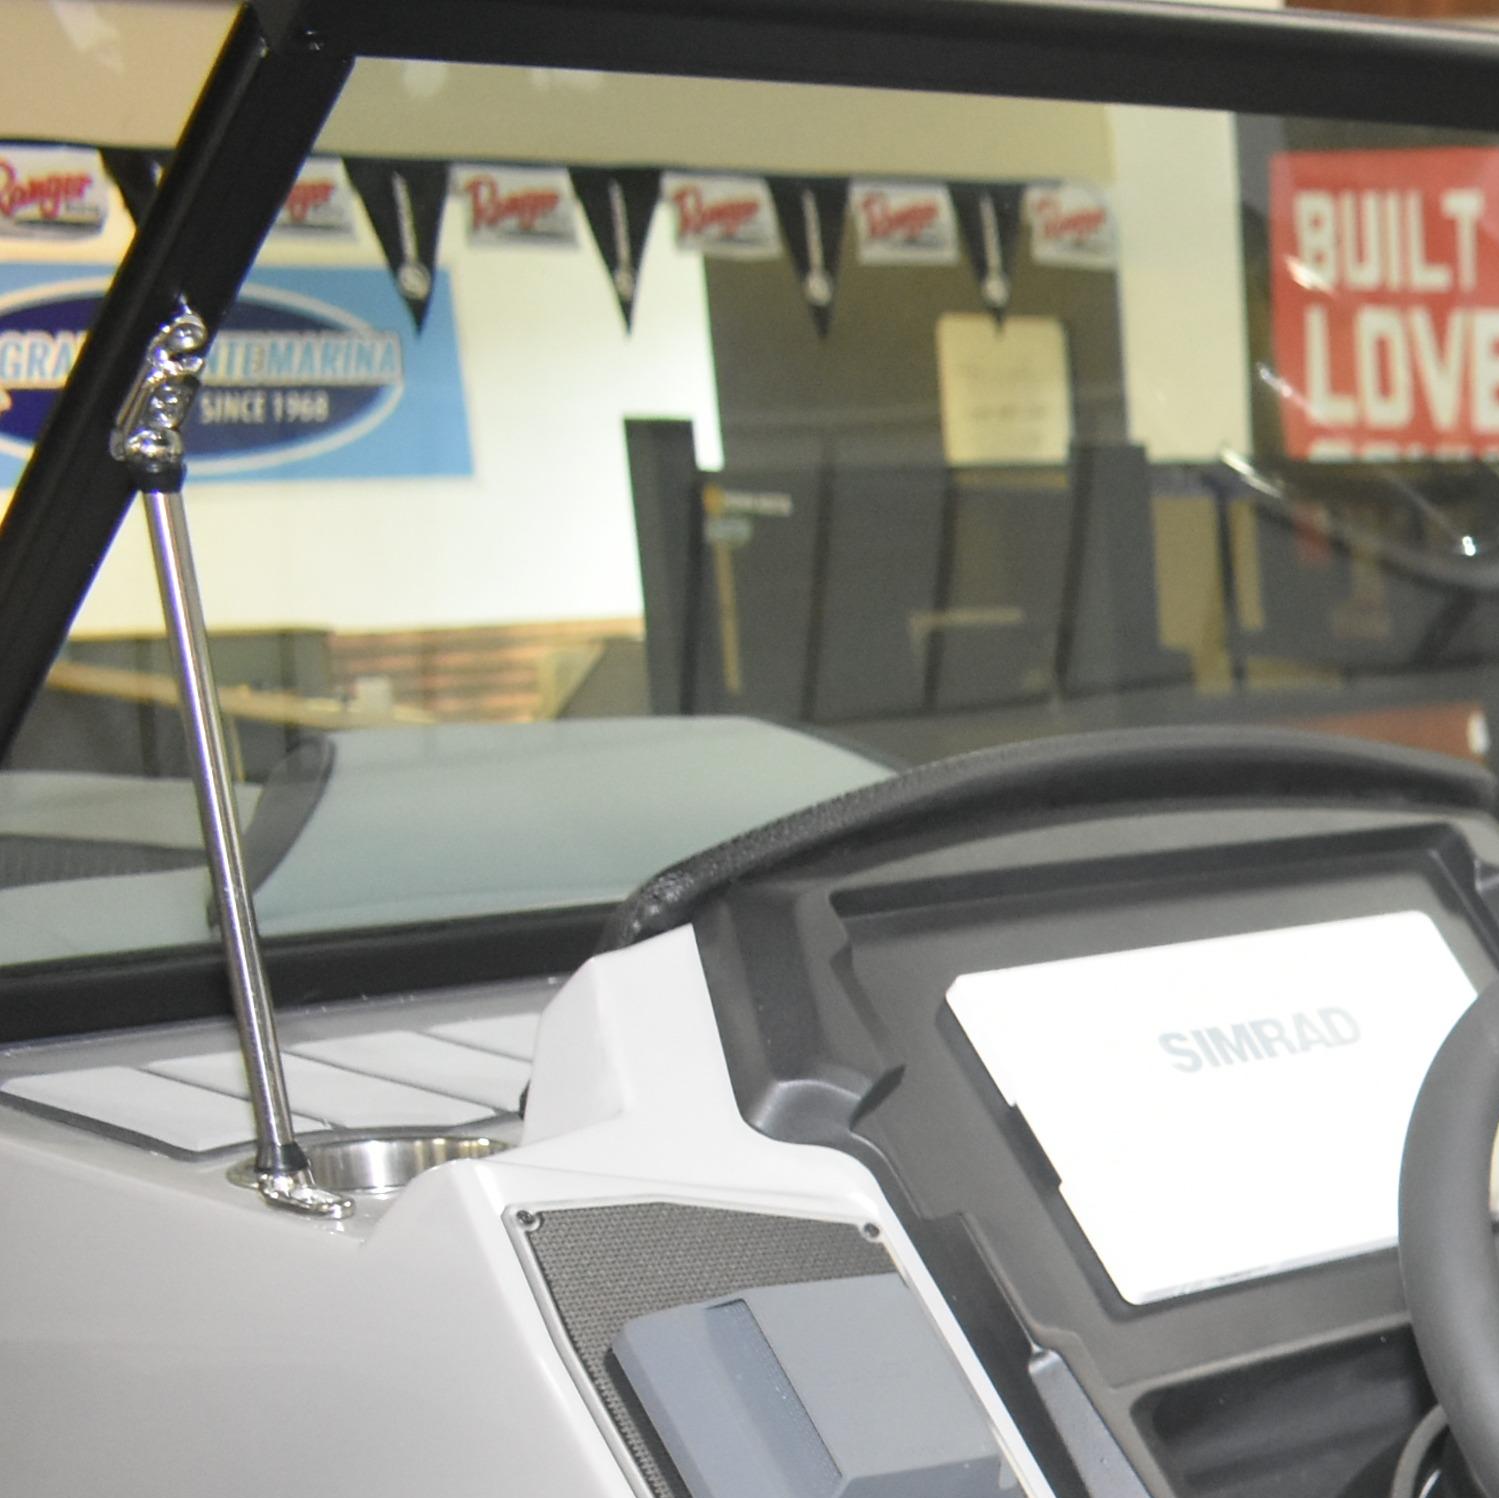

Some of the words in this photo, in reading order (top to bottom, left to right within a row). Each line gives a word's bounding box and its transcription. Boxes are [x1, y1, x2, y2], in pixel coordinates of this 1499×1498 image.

[1294, 191, 1486, 294] BUILT
[201, 392, 267, 424] SINCE
[273, 391, 330, 422] 1968
[1158, 1006, 1361, 1073] SIMRAD
